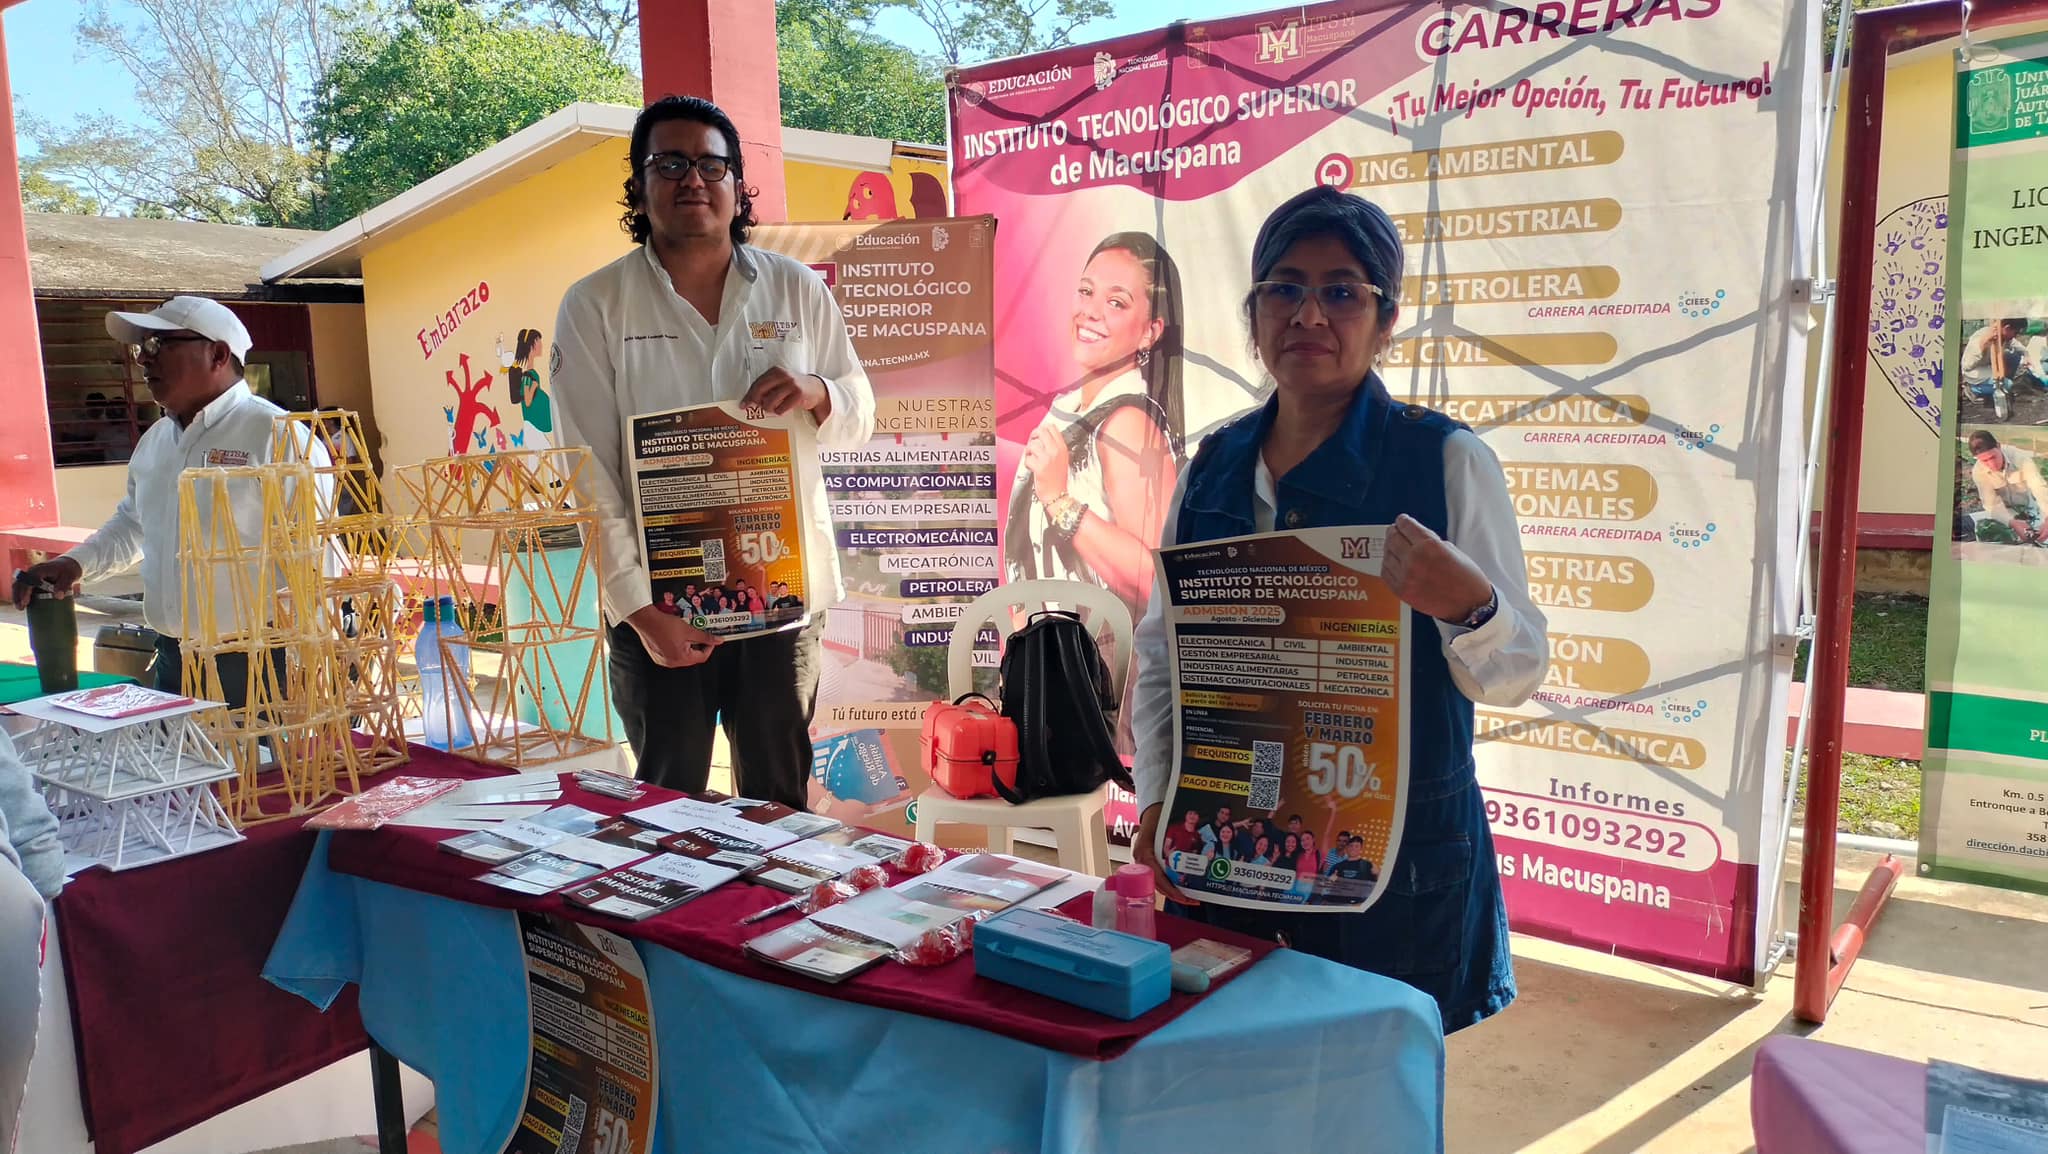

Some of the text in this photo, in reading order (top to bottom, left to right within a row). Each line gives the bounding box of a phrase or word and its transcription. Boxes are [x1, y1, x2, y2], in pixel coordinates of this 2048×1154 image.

[988, 64, 1073, 95] EDUCACIÓN
[1388, 60, 1772, 136] ¡Tu Mejor Opción, Tu Futuro!
[964, 78, 1357, 160] INSTITUTO TECNOLÓGICO SUPERIOR
[1050, 140, 1241, 186] de Macuspana
[1359, 139, 1595, 183] ING. AMBIENTAL
[1422, 206, 1598, 240] INDUSTRIAL
[856, 233, 920, 246] Educación
[842, 262, 935, 278] INSTITUTO
[842, 279, 971, 298] TECNOLÓGICO
[1424, 273, 1584, 304] PETROLERA
[843, 302, 933, 318] SUPERIOR
[1527, 297, 1710, 319] CARRERA ACREDITADA CIEES
[417, 281, 490, 361] Embarazo
[847, 322, 987, 338] DE MACUSPANA
[858, 350, 930, 369] ANA.TECNM.MX
[1420, 341, 1489, 364] CIVIL
[898, 399, 992, 413] NUESTRAS
[876, 414, 993, 431] NGENIERÍAS:
[641, 429, 759, 447] INSTITUTO TECNOLÓGICO
[642, 437, 767, 455] SUPERIOR DE MACUSPANA
[1523, 430, 1704, 446] CARRERA ACREDITADA CIEES
[818, 450, 990, 464] USTRIAS ALIMENTARIAS
[846, 475, 992, 489] COMPUTACIONALES
[1504, 467, 1620, 492] STEMAS
[829, 501, 992, 516] GESTIÓN EMPRESARIAL
[1510, 494, 1635, 521] ONALES
[734, 512, 781, 525] FEBRERO
[850, 529, 994, 545] ELECTROMECÁNICA
[1520, 524, 1701, 542] CARRERA ACREDITADA CIEES
[660, 549, 700, 558] REQUISITOS
[740, 530, 790, 565] 50%
[887, 553, 994, 569] MECATRÓNICA
[1525, 555, 1635, 584] STRIAS
[1198, 566, 1248, 575] TECNOLÓGICO
[1249, 566, 1287, 574] NACIONAL
[910, 580, 994, 594] PETROLERA
[1178, 572, 1358, 589] INSTITUTO TECNOLÓGICO
[1181, 588, 1368, 602] SUPERIOR DE MACUSPANA
[1528, 584, 1593, 608] RIAS
[709, 615, 750, 625] 9361093292
[911, 606, 968, 620] AMBIEN
[1211, 615, 1280, 624] Agosto Diciembre
[1251, 606, 1281, 616] 2025
[1320, 620, 1397, 635] INGENIERÍAS:
[1180, 637, 1389, 654] ELECTROMECÁNICA CIVIL AMBIENTAL
[1547, 634, 1603, 664] IÓN
[974, 652, 996, 664] VIL
[1181, 648, 1388, 669] GESTIÓN EMPRESARIAL INDUSTRIAL
[1183, 662, 1390, 682] INDUSTRIAS ALIMENTARIAS PETROLERA
[1543, 664, 1580, 688] AL
[1183, 674, 1390, 697] SISTEMAS COMPUTACIONALES MECATRÓNICA
[1530, 690, 1691, 716] RRERA ACREDITADA CIEES
[832, 706, 917, 721] Tú futuro está
[1304, 711, 1374, 730] FEBRERO
[1304, 726, 1373, 744] Y MARZO
[1475, 714, 1691, 767] TROMECÁNICA
[1197, 747, 1250, 761] REQUISITOS
[1308, 742, 1382, 798] 50%
[1183, 776, 1250, 792] PAGO DE FICHA
[1549, 777, 1686, 817] Informes
[2003, 789, 2045, 802] Km. 0.5
[1970, 799, 2026, 815] Entronque
[1485, 798, 1688, 859] 9361093292
[2026, 832, 2047, 844] 358
[1233, 866, 1292, 884] 9361093292
[1522, 853, 1672, 910] Macuspana
[526, 931, 563, 954] INSTITUTO
